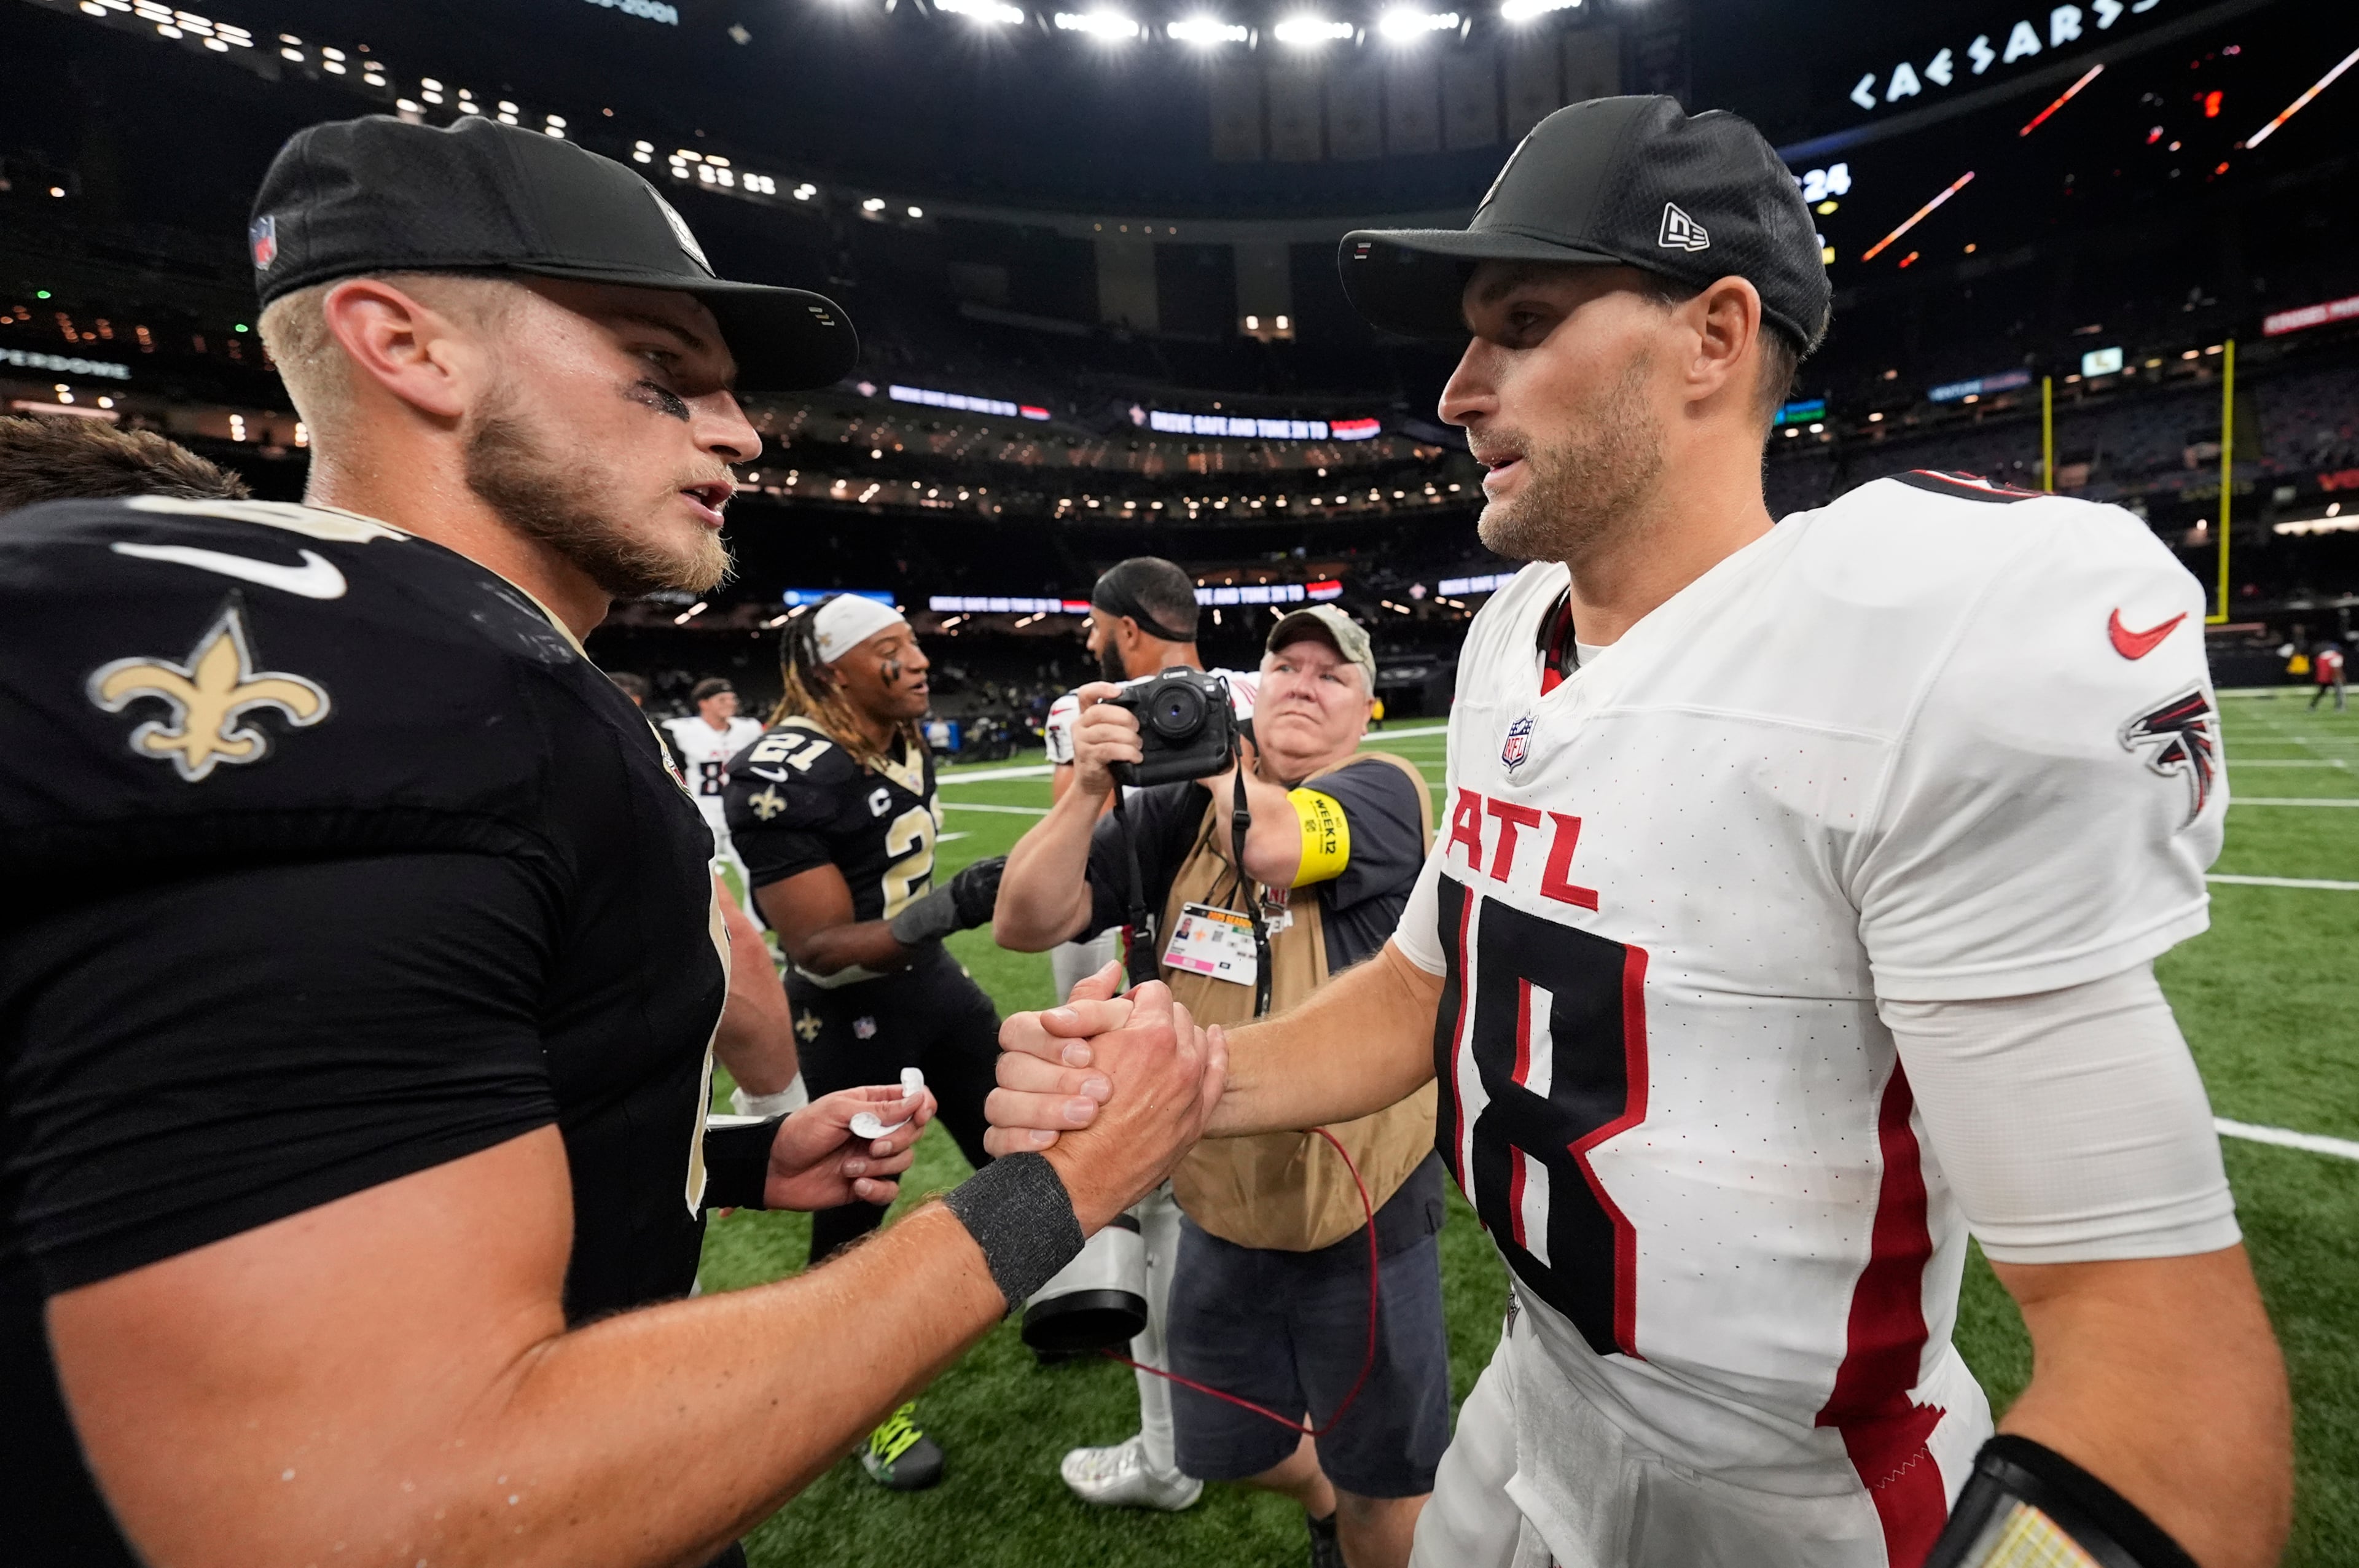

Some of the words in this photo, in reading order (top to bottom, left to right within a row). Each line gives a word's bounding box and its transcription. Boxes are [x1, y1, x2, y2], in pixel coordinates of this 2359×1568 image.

[1850, 0, 2124, 111] CAESARS
[748, 733, 832, 772] 21
[1504, 737, 1524, 761] NFL
[699, 762, 729, 797] 8
[868, 788, 891, 817] C
[1315, 799, 1336, 838] WEEK
[881, 794, 944, 921] 2
[1325, 840, 1336, 855] 12
[1446, 787, 1599, 913] ATL
[1434, 870, 1649, 1360] 18
